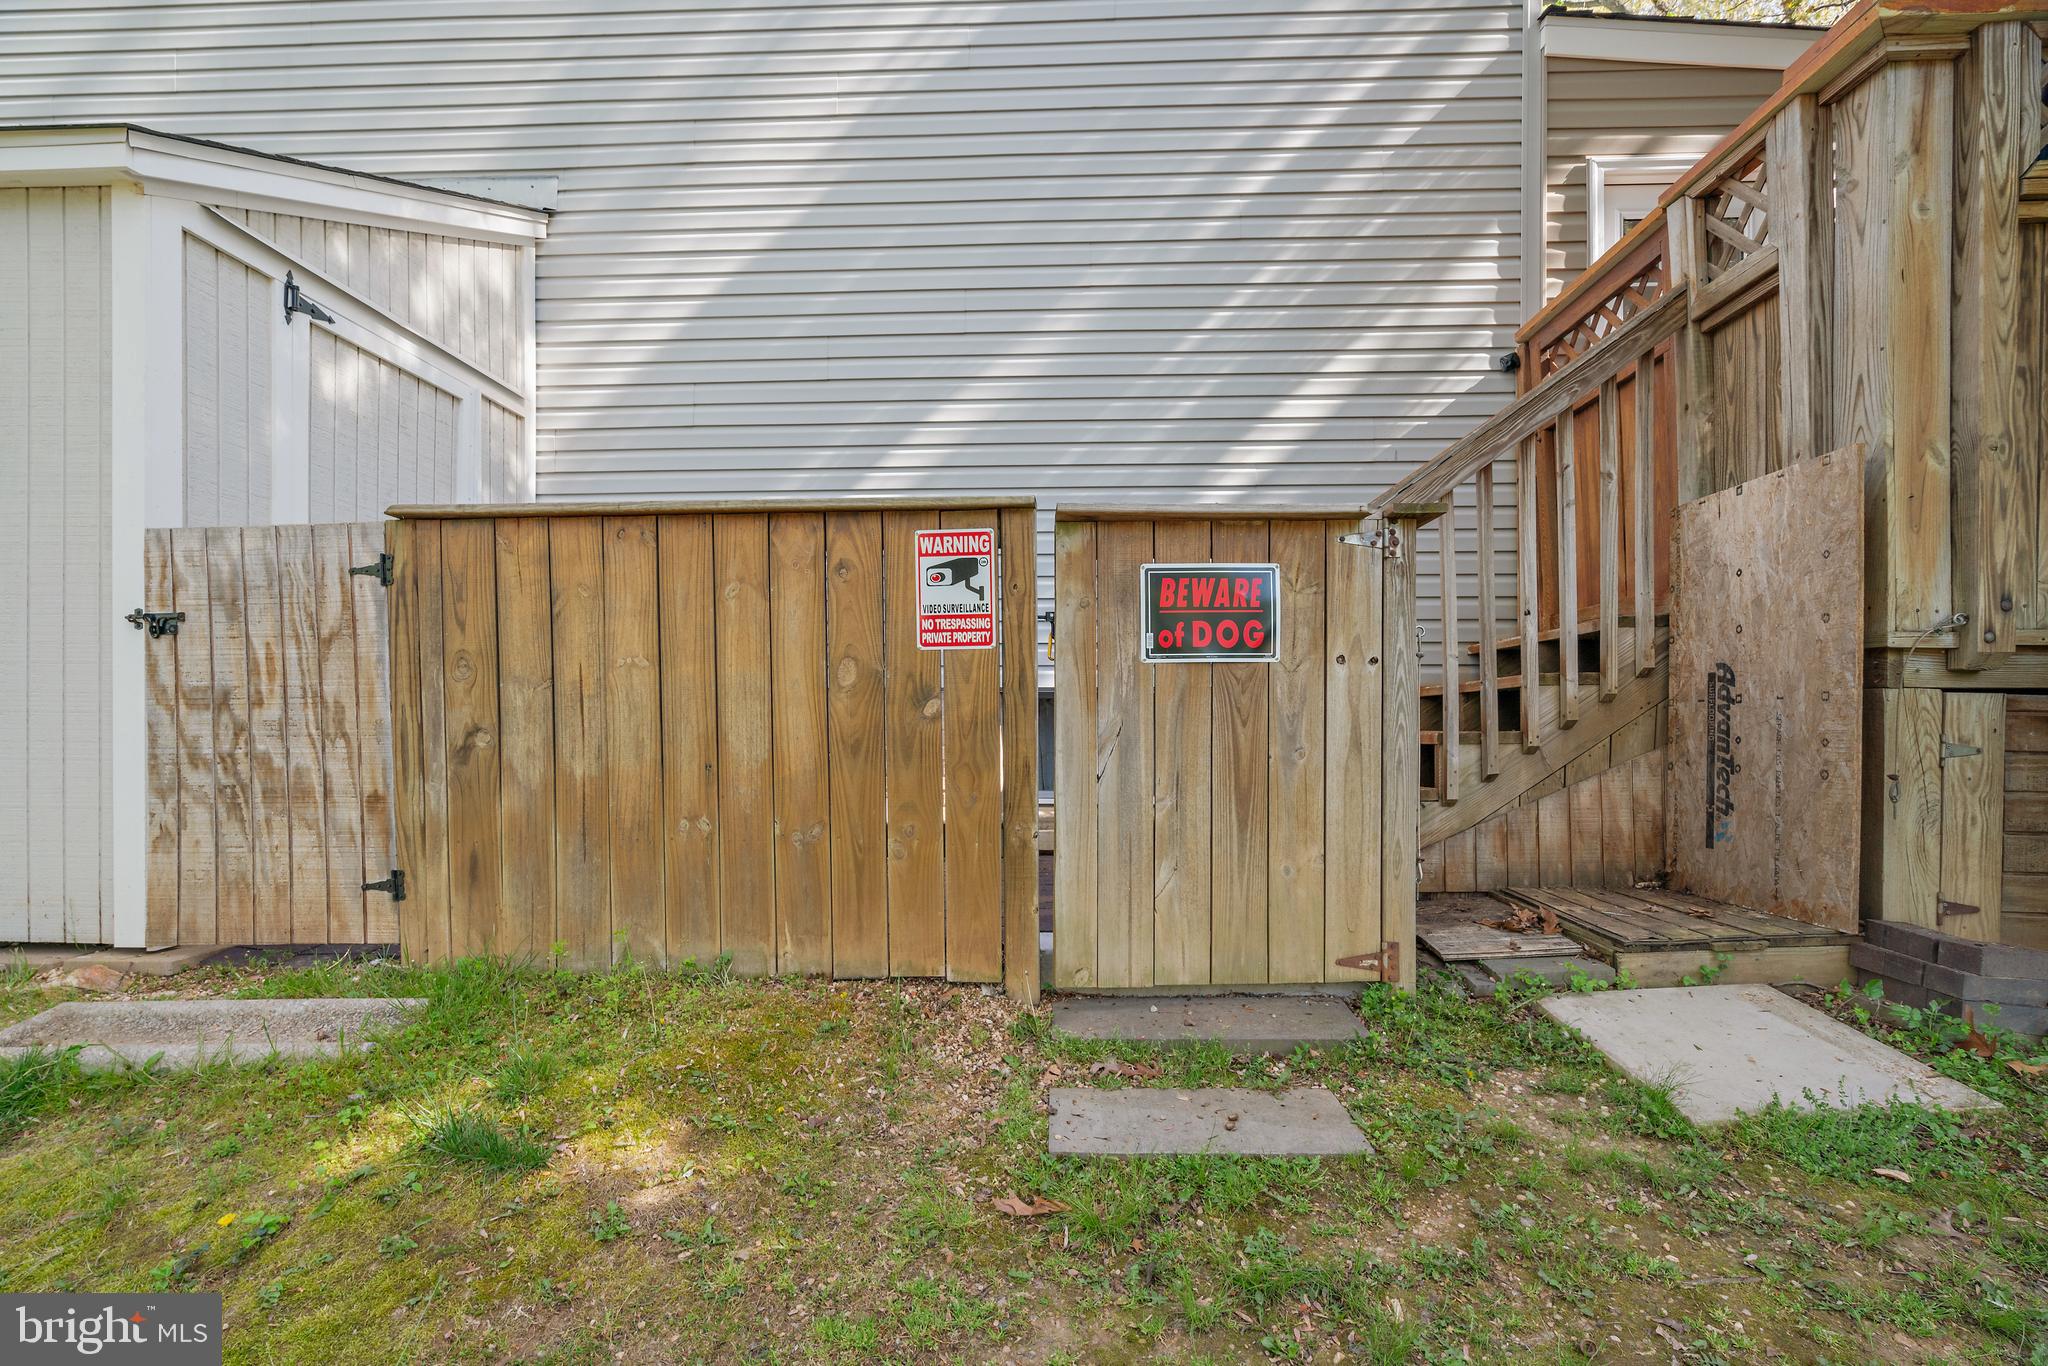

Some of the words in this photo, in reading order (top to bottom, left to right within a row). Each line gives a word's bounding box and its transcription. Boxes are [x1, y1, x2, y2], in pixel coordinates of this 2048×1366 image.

[920, 535, 990, 554] WARNING
[1159, 577, 1263, 608] BEWARE
[922, 604, 941, 614] VIDEO
[942, 603, 989, 614] SURVEILLANCE
[921, 619, 934, 630] NO
[935, 617, 991, 630] TRESPASSING
[922, 632, 952, 644] PRIVATE
[952, 631, 991, 643] PROPERTY
[1158, 621, 1185, 649] of
[1192, 619, 1265, 649] DOG
